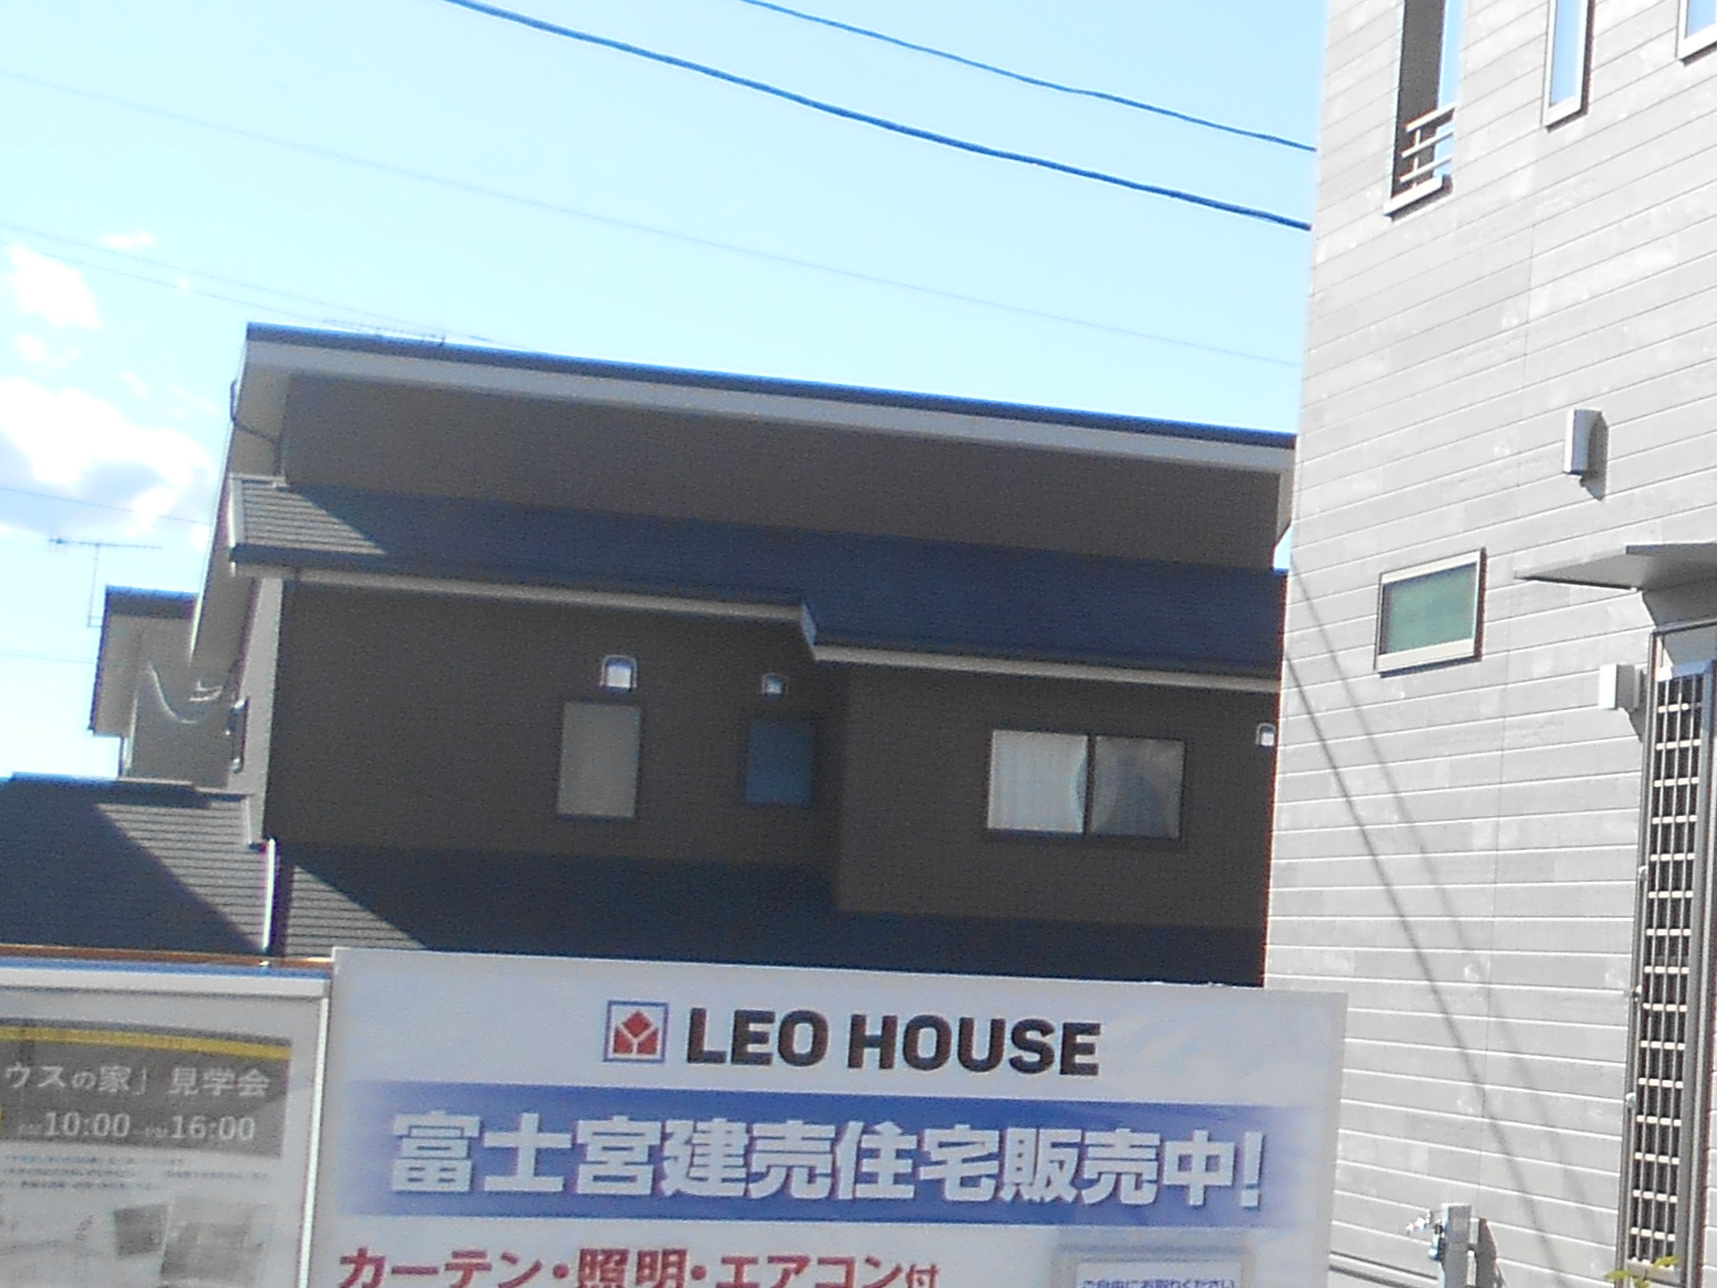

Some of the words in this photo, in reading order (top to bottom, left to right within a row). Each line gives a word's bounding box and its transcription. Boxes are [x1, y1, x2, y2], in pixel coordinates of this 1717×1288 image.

[687, 1009, 828, 1066] LEO
[848, 1014, 1101, 1076] HOUSE
[168, 1067, 271, 1097] 見学会
[391, 1110, 1265, 1210] 富士宮建売住宅販売中!
